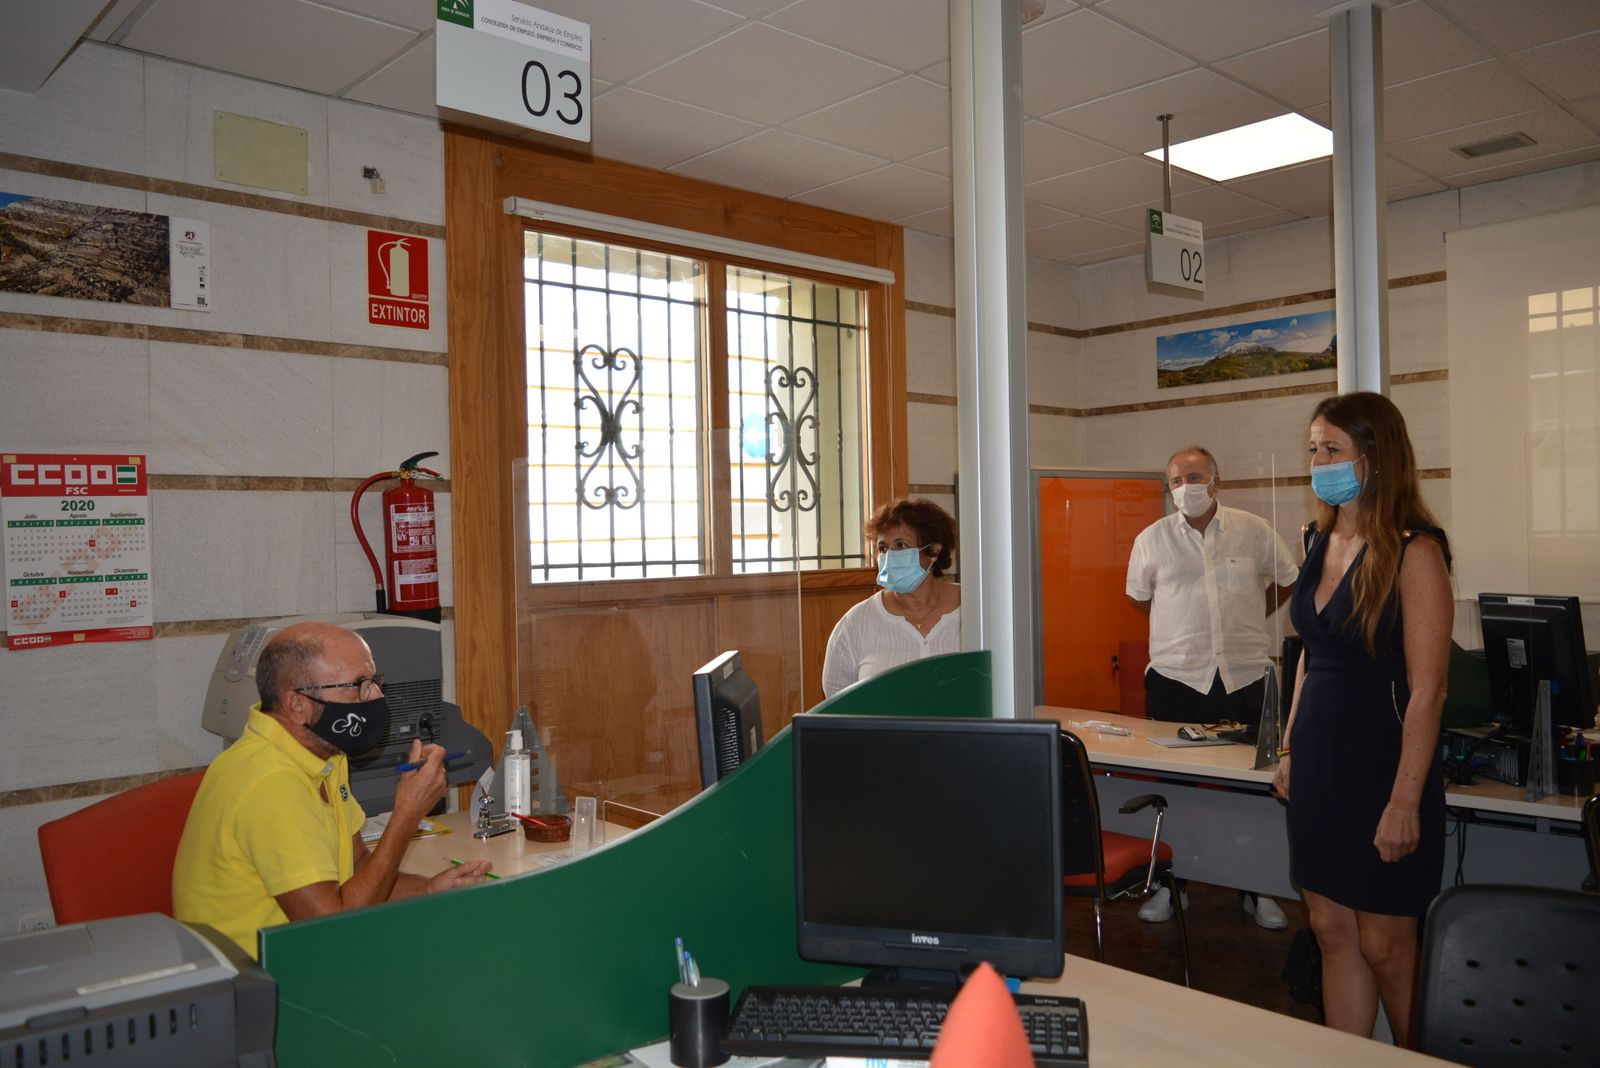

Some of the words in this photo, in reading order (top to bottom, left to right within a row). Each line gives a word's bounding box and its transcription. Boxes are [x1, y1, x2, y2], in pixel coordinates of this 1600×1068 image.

[511, 14, 533, 28] Servicio
[534, 20, 556, 34] Andaluz
[563, 29, 583, 43] Empleo
[536, 32, 556, 44] EMPRESA
[560, 38, 583, 52] COMERCIO
[521, 60, 583, 125] 03
[1180, 248, 1203, 284] 02
[371, 303, 426, 324] EXTINTOR
[10, 464, 114, 485] CCOO
[65, 487, 88, 495] FSC
[61, 500, 95, 511] 2020
[13, 636, 44, 646] CCOO
[911, 932, 940, 945] inves
